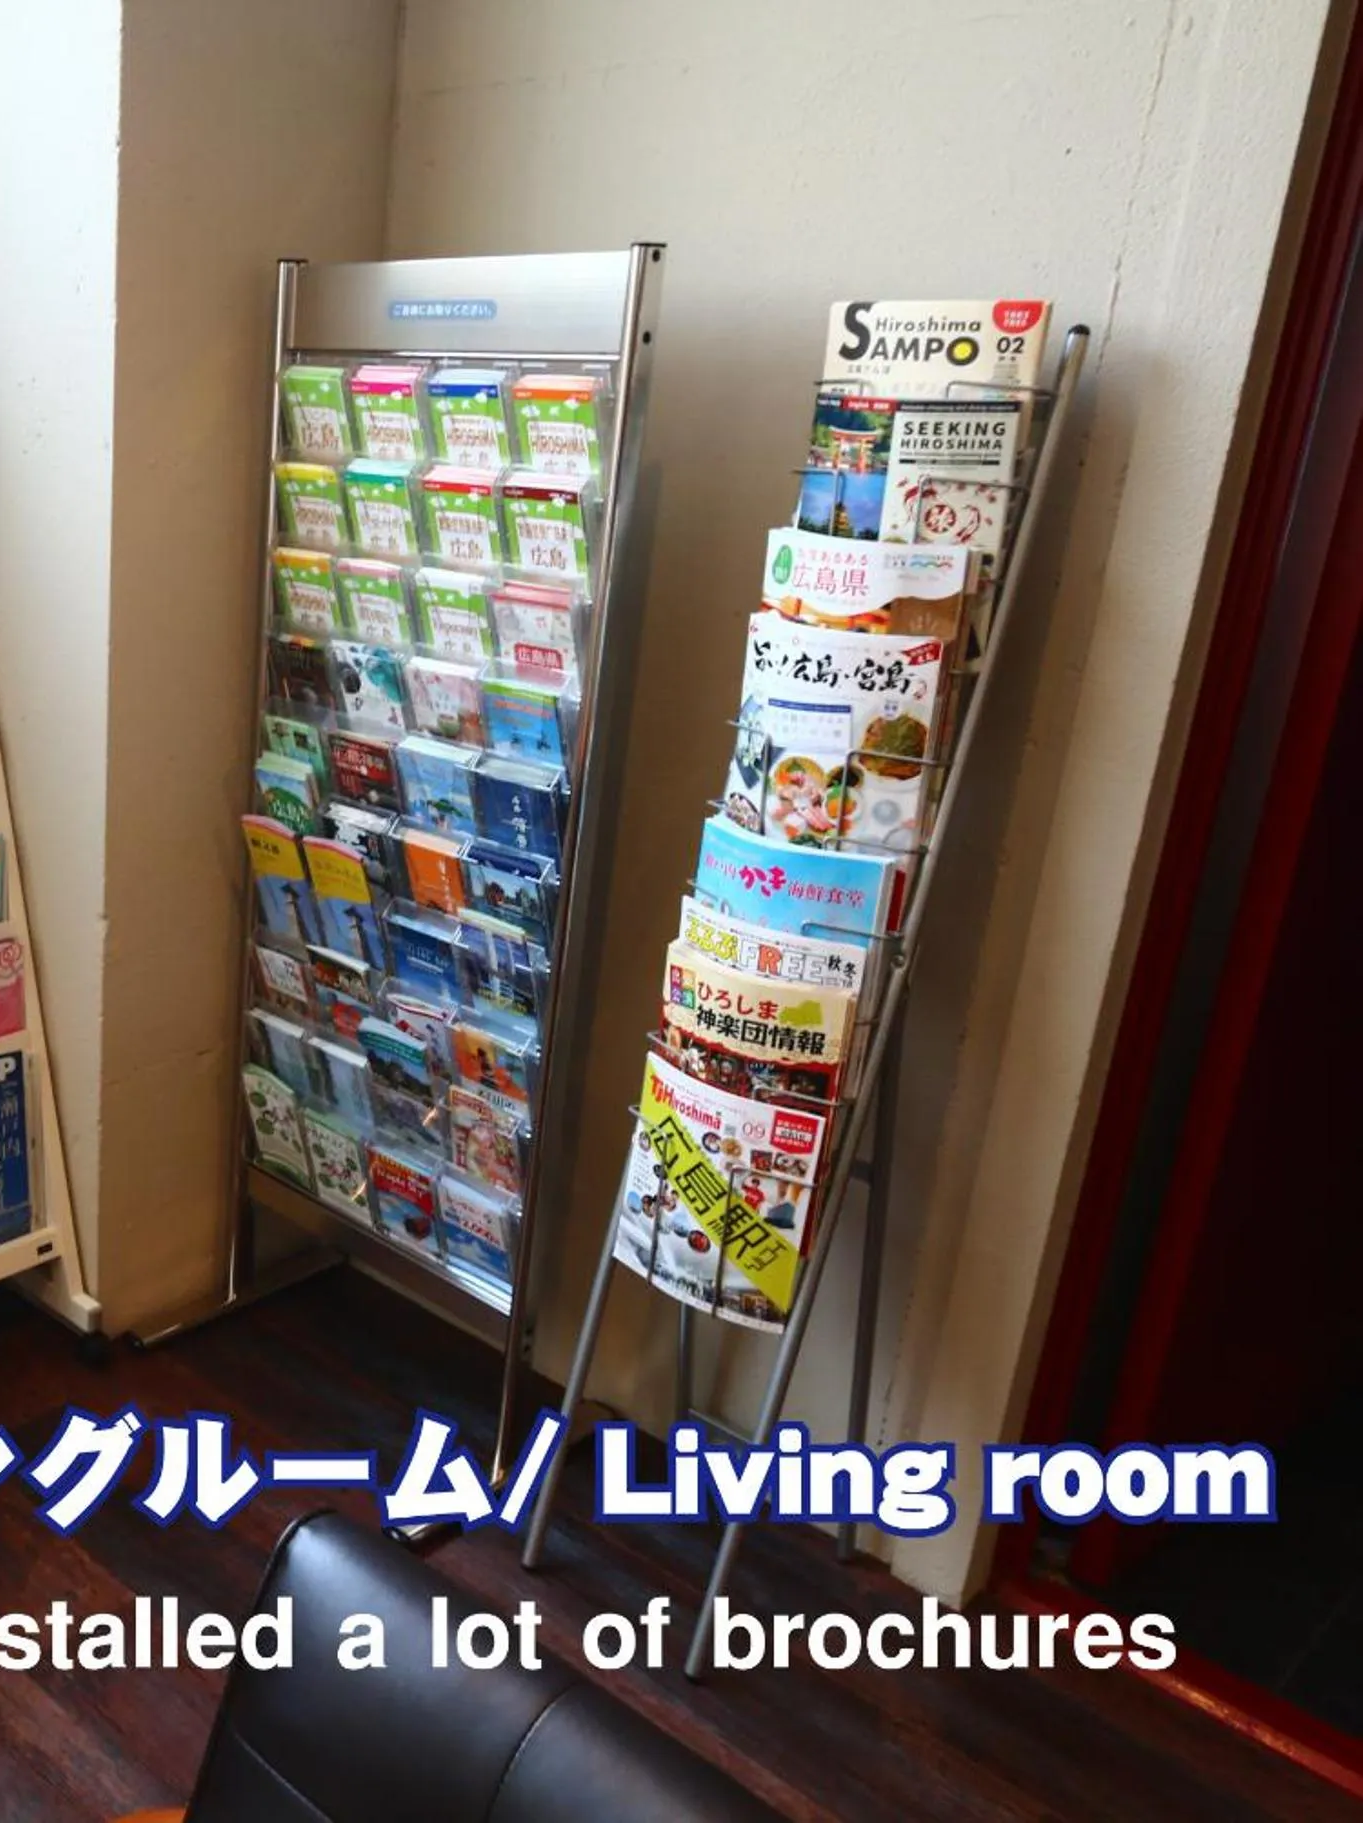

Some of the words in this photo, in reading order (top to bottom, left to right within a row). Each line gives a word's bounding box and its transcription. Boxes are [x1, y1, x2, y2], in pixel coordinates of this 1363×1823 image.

[839, 302, 980, 366] SAMPO
[875, 316, 982, 333] Hiroshima
[996, 336, 1025, 354] 02
[903, 421, 1007, 437] SEEKING
[900, 437, 1003, 451] HIROSHIMA
[449, 538, 484, 561] 広島
[530, 543, 567, 571] 広島
[791, 562, 871, 597] 広島県
[684, 914, 738, 961] るるぶ
[739, 938, 827, 986] FREE
[827, 954, 857, 977] 秋冬
[697, 981, 778, 1020] ひろしま
[696, 1005, 826, 1056] 神楽団情報
[742, 1120, 766, 1139] 09
